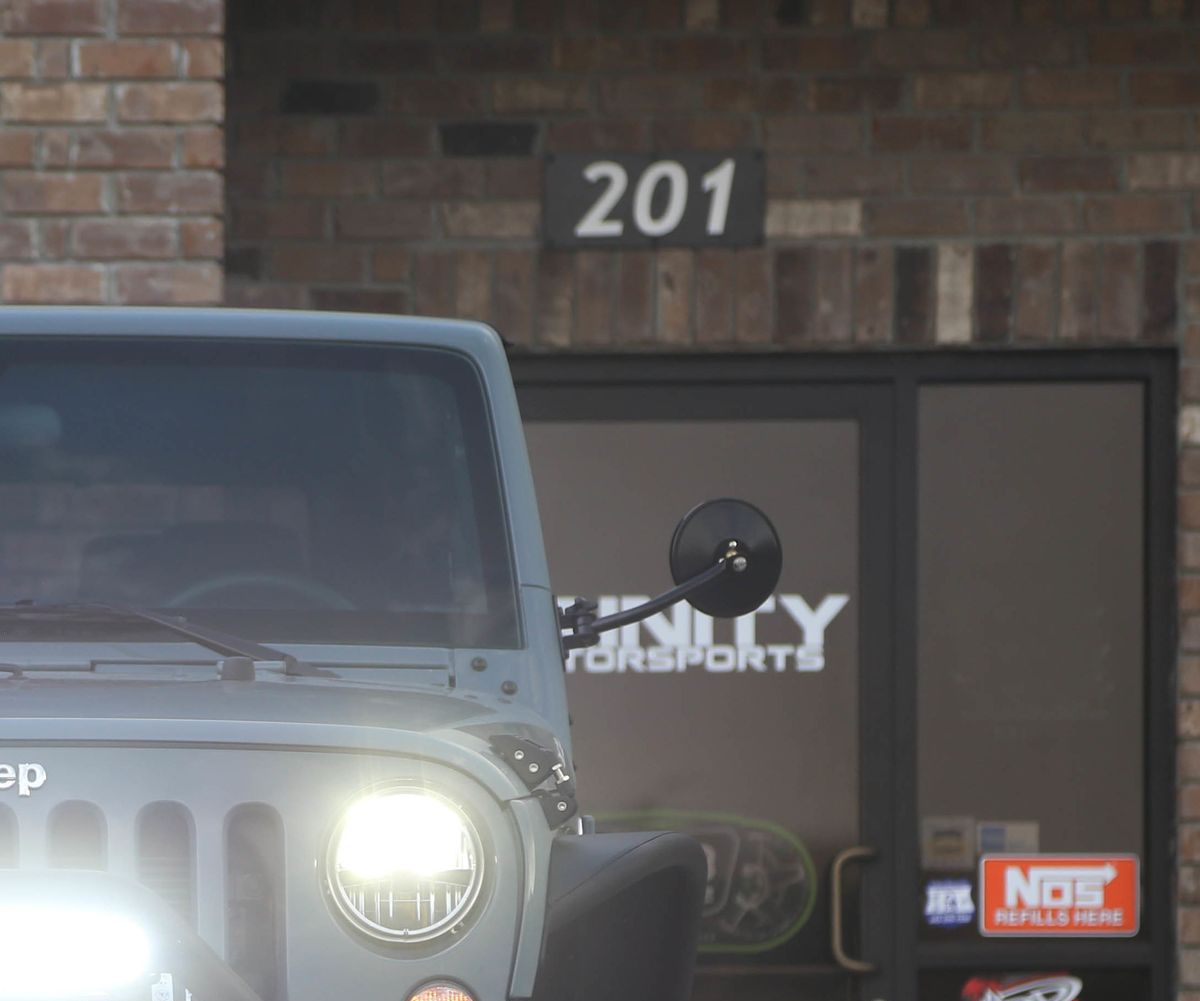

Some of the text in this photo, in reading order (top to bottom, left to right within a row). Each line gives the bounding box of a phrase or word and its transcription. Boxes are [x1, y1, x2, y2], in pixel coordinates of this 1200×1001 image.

[574, 158, 736, 237] 201
[565, 644, 825, 673] TORSPORTS
[1005, 864, 1116, 908] NOS
[994, 908, 1124, 926] REFILLS HERE
